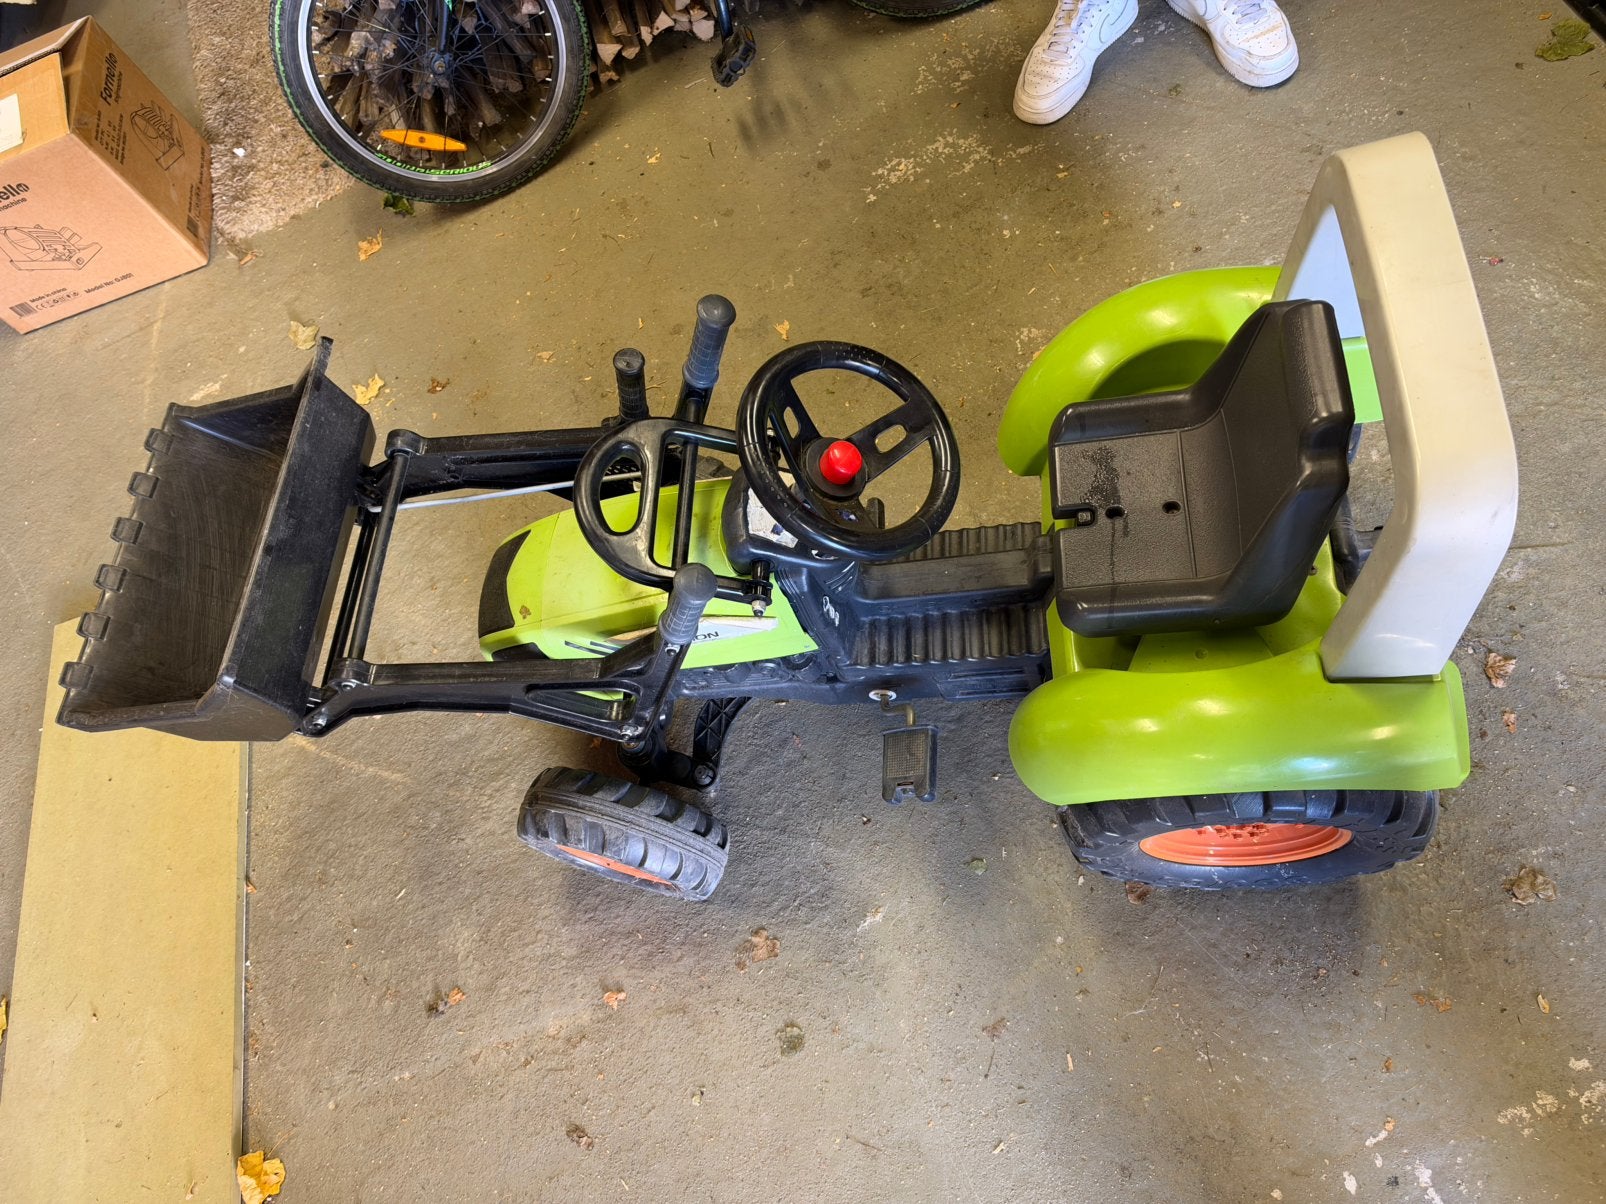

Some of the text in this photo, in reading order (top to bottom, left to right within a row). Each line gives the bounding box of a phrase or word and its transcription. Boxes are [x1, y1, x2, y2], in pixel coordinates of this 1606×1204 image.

[100, 52, 118, 106] Fornello
[0, 182, 30, 202] ello
[692, 631, 720, 642] ON
